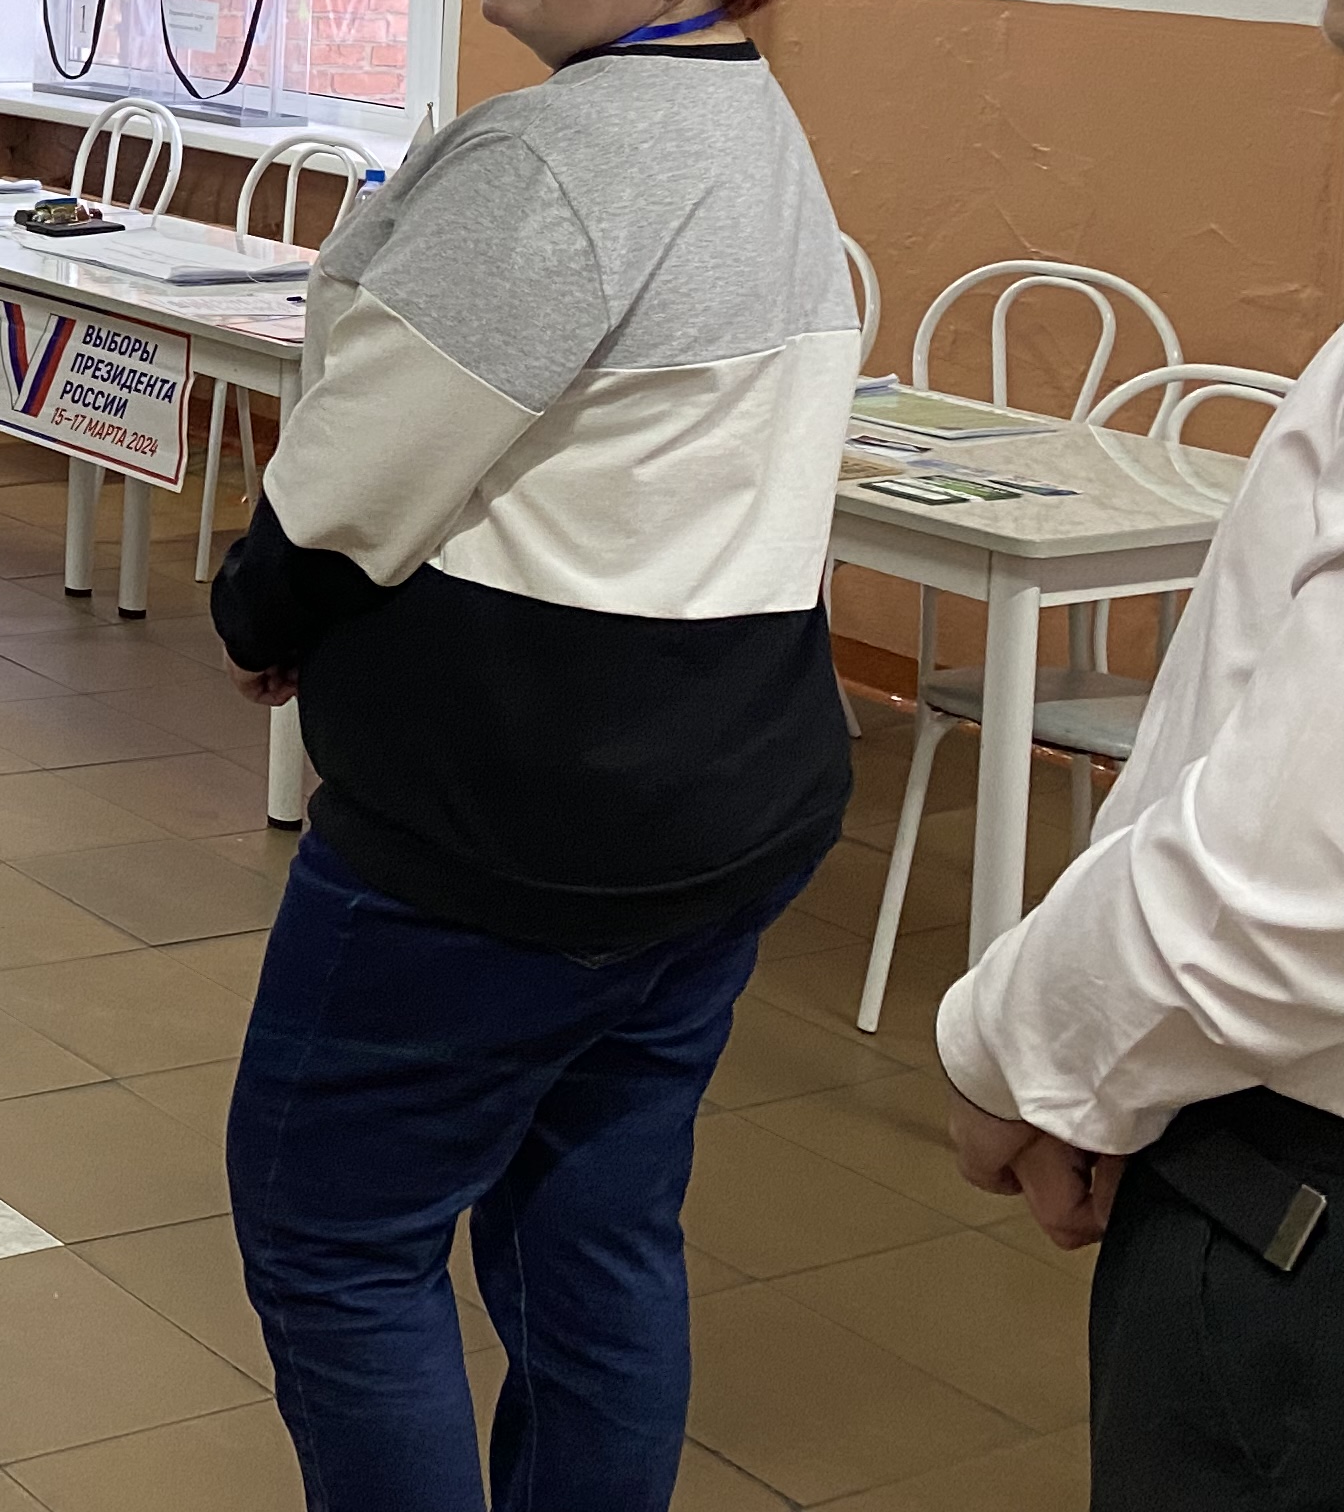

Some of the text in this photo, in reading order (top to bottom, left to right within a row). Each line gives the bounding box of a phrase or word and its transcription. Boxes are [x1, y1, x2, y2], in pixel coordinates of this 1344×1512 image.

[82, 324, 158, 365] ВЫБОРЫ
[70, 352, 177, 404] ПРЕЗИДЕНТА
[59, 380, 129, 419] РОССИИ
[83, 418, 128, 447] МАРТА
[126, 431, 159, 457] 2024
